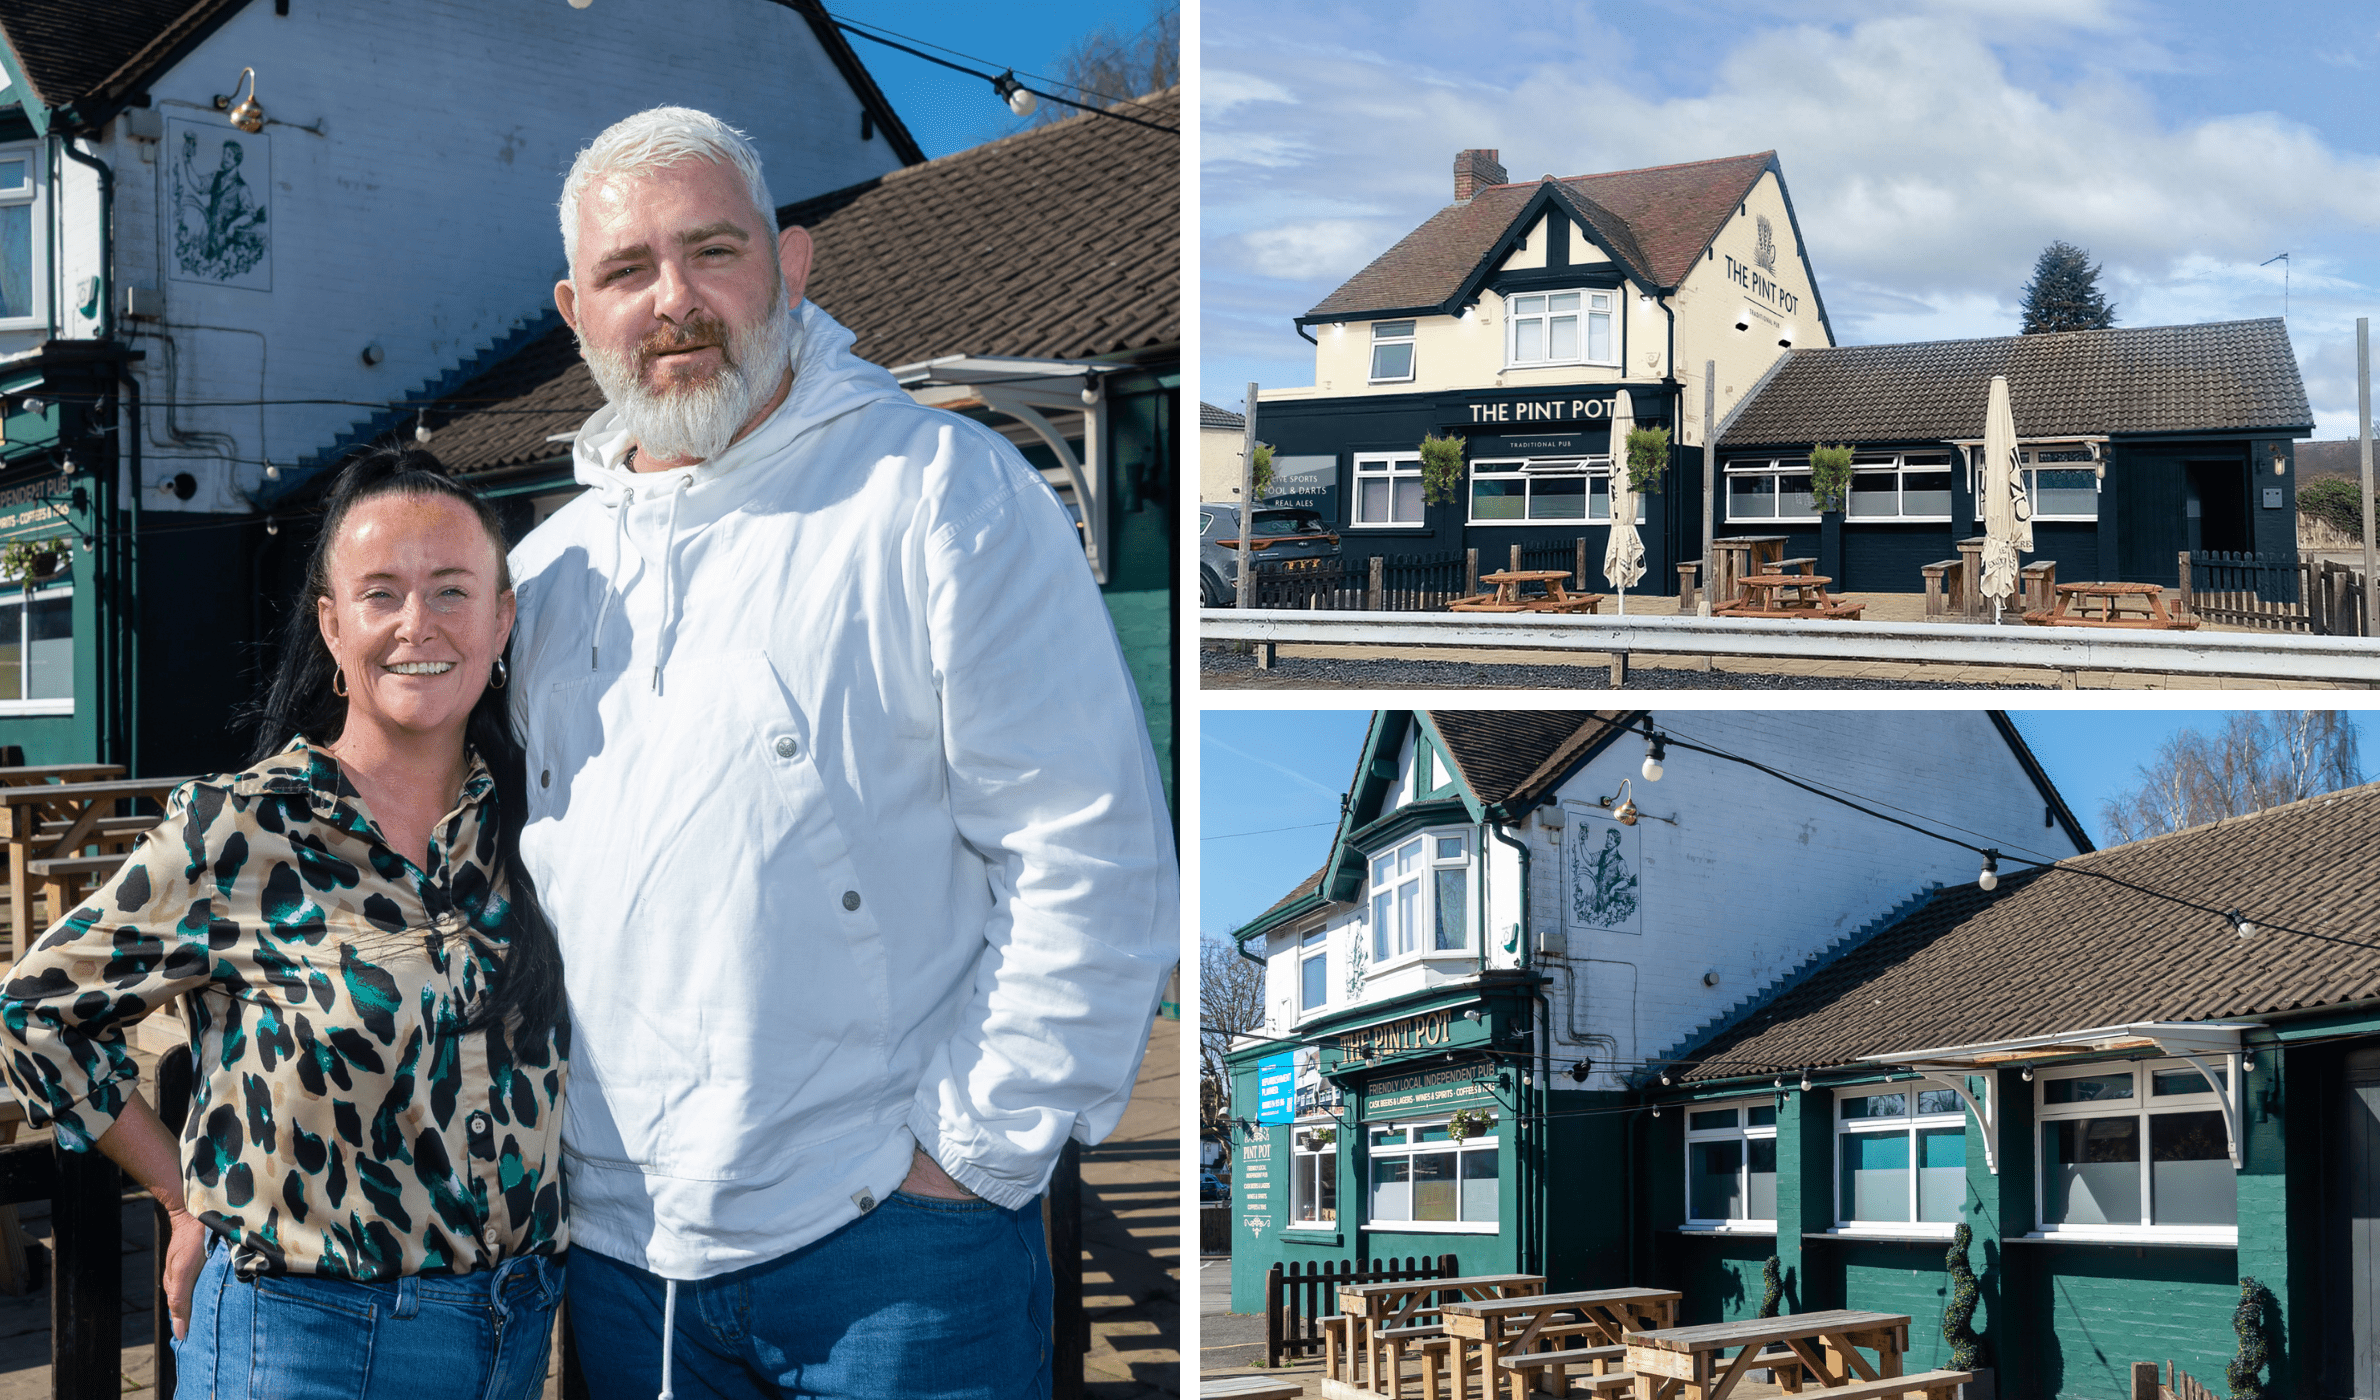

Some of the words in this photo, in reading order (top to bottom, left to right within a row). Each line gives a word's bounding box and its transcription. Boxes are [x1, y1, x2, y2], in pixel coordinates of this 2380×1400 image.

[1725, 254, 1748, 289] THE
[1753, 271, 1776, 304] PINT
[1780, 288, 1798, 316] POT
[1469, 404, 1510, 422] THE
[1516, 401, 1566, 421] PINT
[1572, 399, 1615, 419] POT
[1289, 486, 1296, 495] &
[1299, 486, 1327, 495] DARTS
[1290, 475, 1318, 483] SPORTS
[1374, 1019, 1411, 1057] PINT
[1414, 1009, 1451, 1048] POT
[1368, 1080, 1399, 1096] FRIENDLY
[1400, 1076, 1423, 1091] LOCAL
[1424, 1066, 1477, 1087] INDEPENDENT
[1478, 1064, 1495, 1078] PUB
[1243, 1145, 1258, 1160] PINT
[1258, 1144, 1271, 1158] POT
